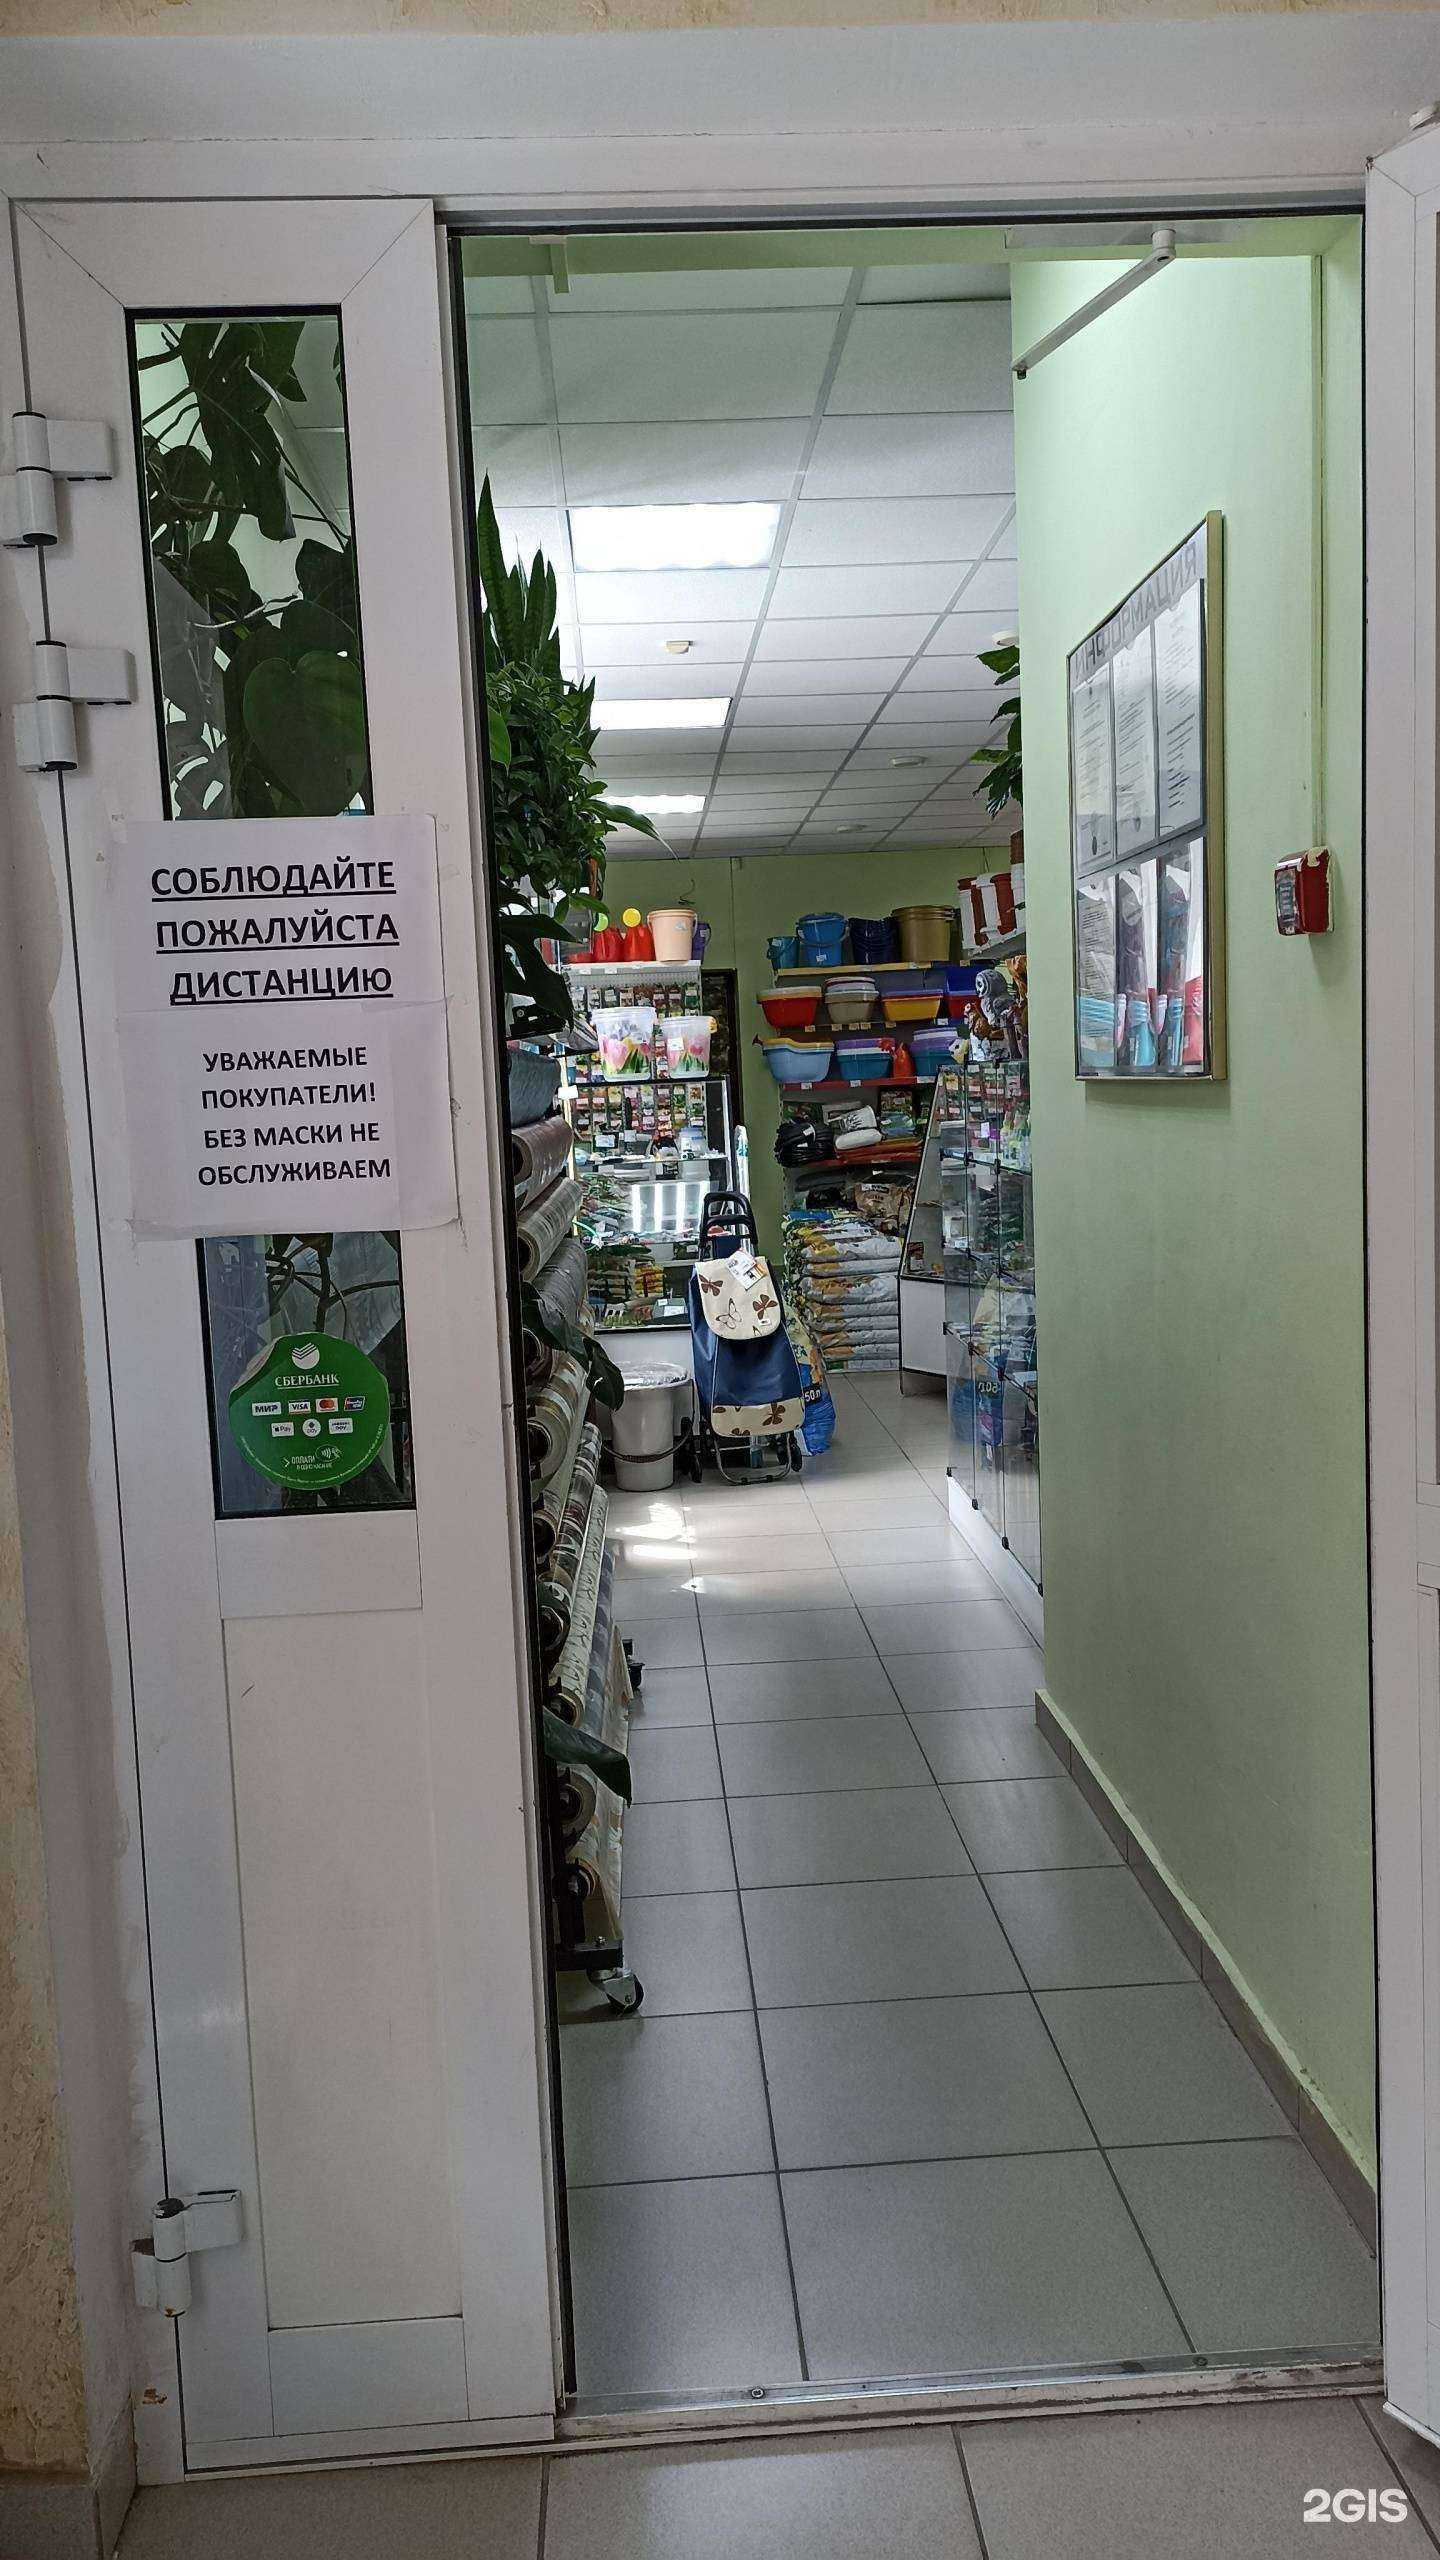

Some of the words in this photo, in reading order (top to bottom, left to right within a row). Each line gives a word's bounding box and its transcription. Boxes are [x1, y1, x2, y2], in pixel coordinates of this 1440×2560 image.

[1074, 541, 1197, 683] ИНФОРМАЦИЯ
[151, 856, 396, 897] СОБЛЮДАЙТЕ
[156, 909, 399, 949] ПОЖАЛУЙСТА
[170, 967, 392, 1002] ДИСТАНЦИЮ
[203, 1046, 367, 1072] УВАЖАЕМЫЕ
[202, 1082, 376, 1109] ПОКУПАТЕЛИ!
[204, 1127, 246, 1149] БЕЗ
[254, 1124, 343, 1147] МАСКИ
[351, 1122, 380, 1143] НЕ
[198, 1158, 391, 1186] ОБСЛУЖИВАЕМ
[275, 1374, 340, 1387] СБЕРБАНК
[255, 1404, 278, 1413] МИР
[292, 1403, 309, 1411] VISA
